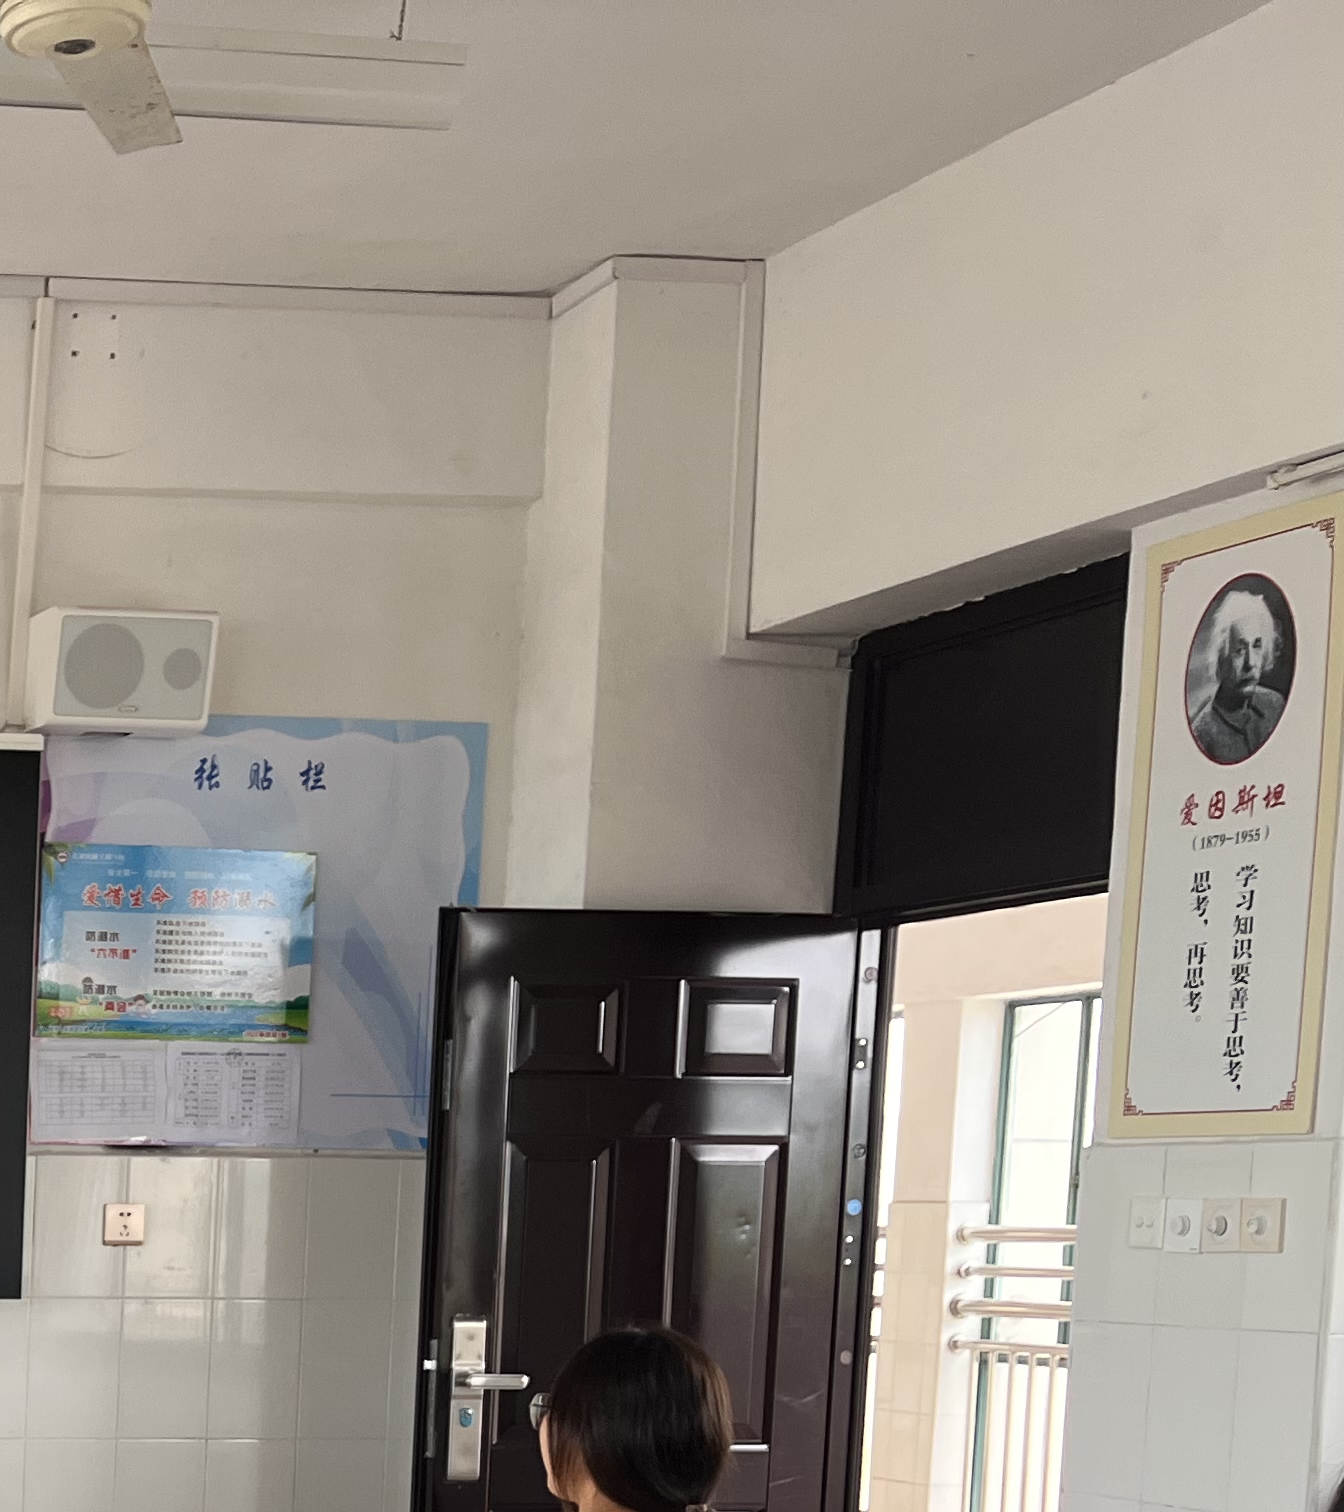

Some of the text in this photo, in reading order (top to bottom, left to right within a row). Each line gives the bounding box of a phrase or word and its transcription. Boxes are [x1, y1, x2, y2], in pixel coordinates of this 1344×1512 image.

[194, 755, 328, 793] 张贴栏
[1179, 783, 1288, 827] 爱因斯坦
[80, 882, 173, 910] 爱惜生命
